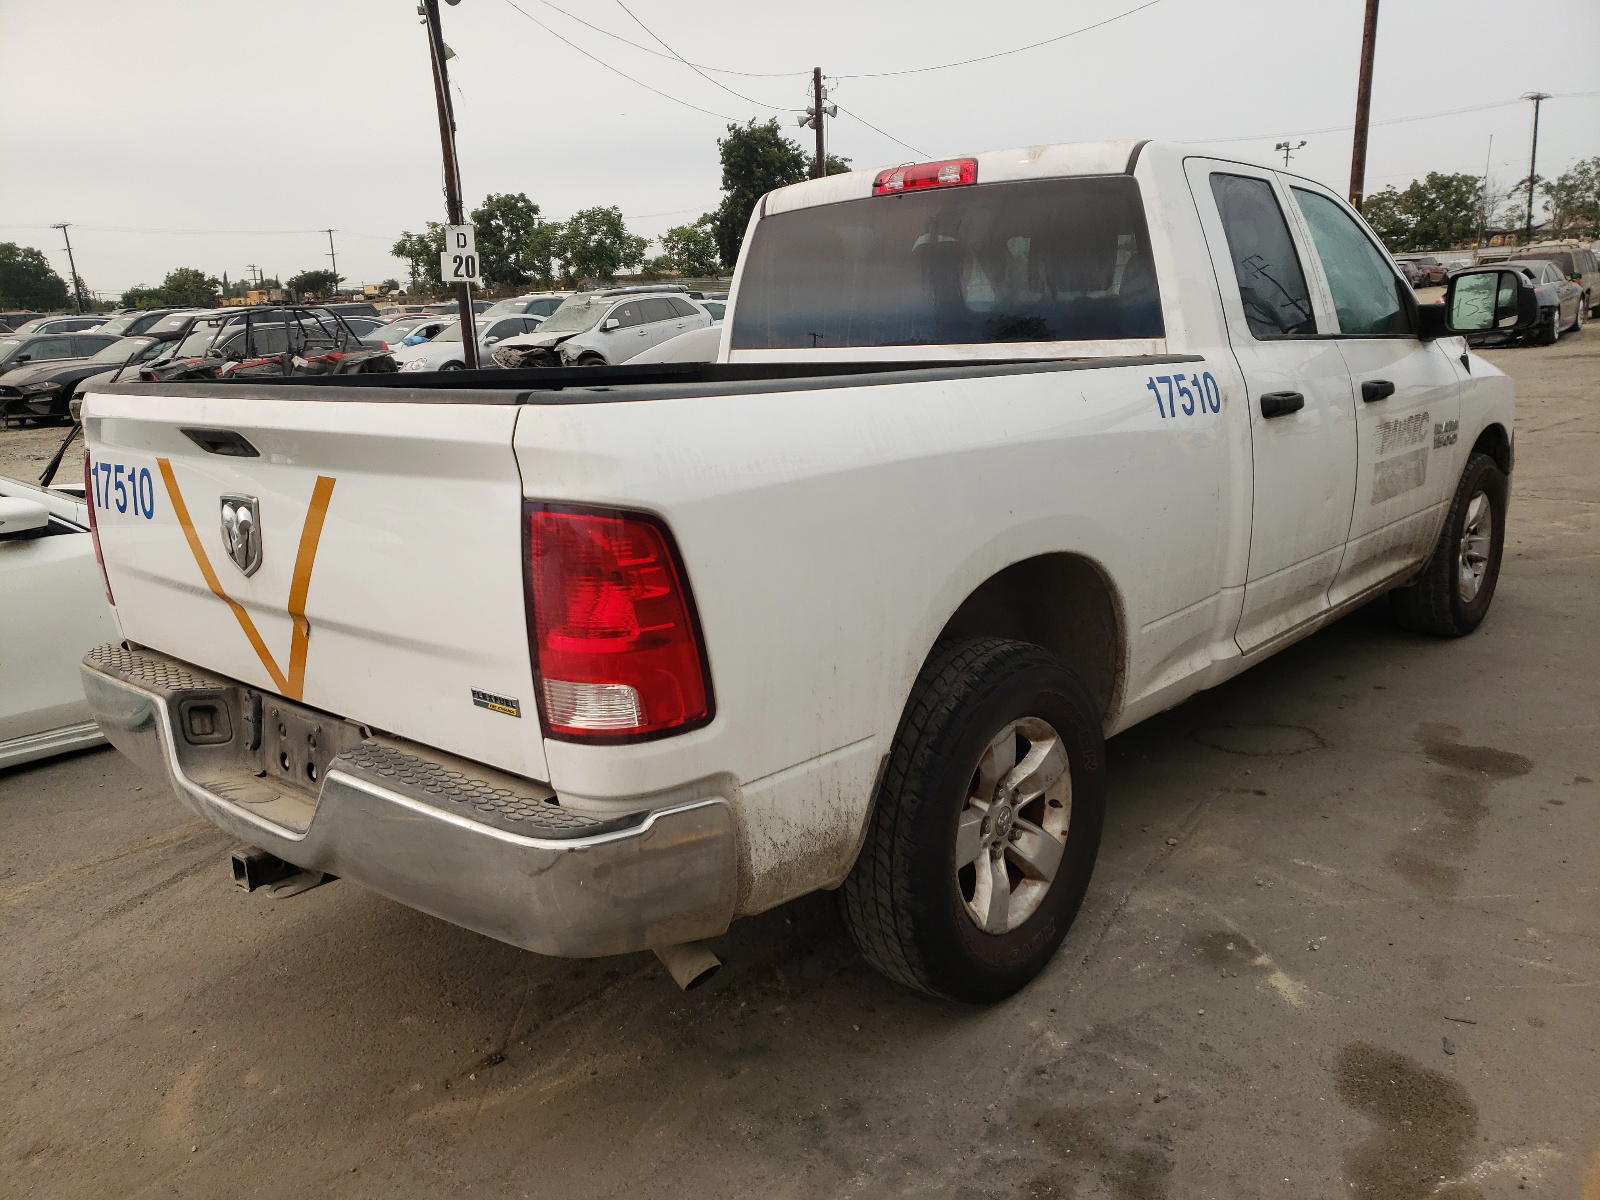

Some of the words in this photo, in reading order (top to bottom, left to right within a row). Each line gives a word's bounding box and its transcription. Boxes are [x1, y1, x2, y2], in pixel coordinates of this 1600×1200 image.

[457, 233, 467, 248] D
[453, 255, 475, 278] 20
[1147, 372, 1220, 418] 17510
[92, 462, 154, 519] 17510
